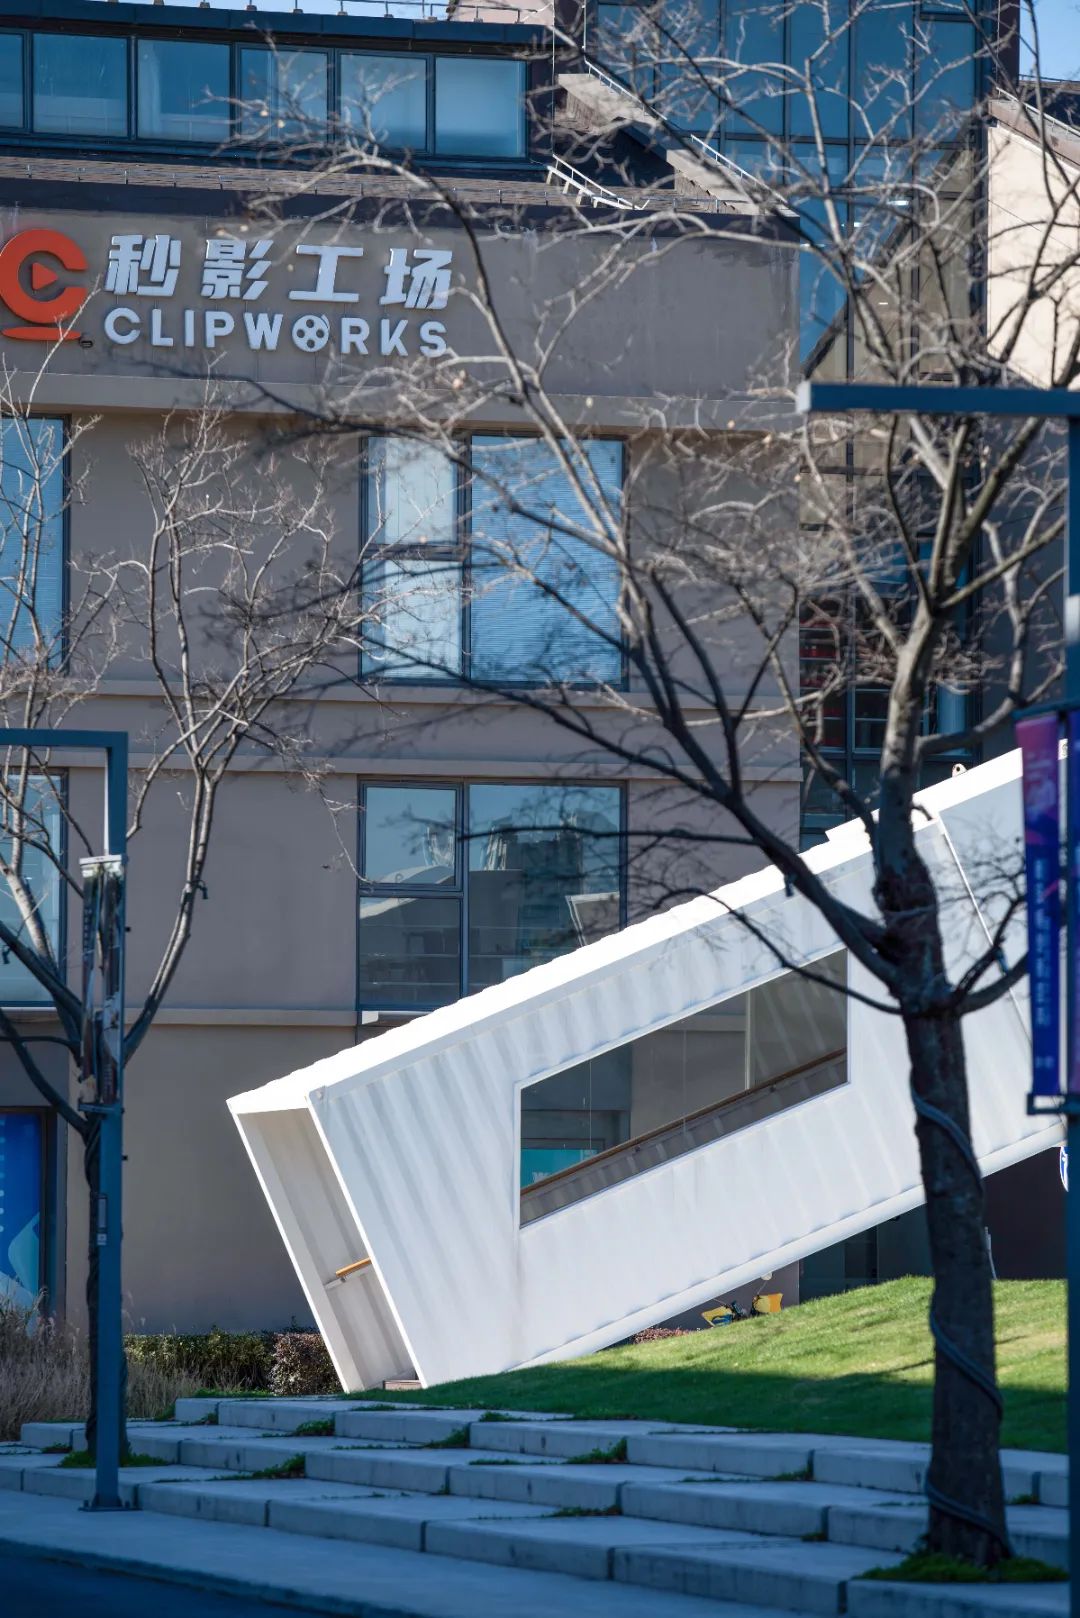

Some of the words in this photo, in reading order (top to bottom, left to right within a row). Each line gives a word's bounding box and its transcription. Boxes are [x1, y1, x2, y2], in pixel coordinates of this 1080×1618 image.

[104, 234, 453, 310] 秒影工场
[103, 307, 448, 357] CLIPWORKS
